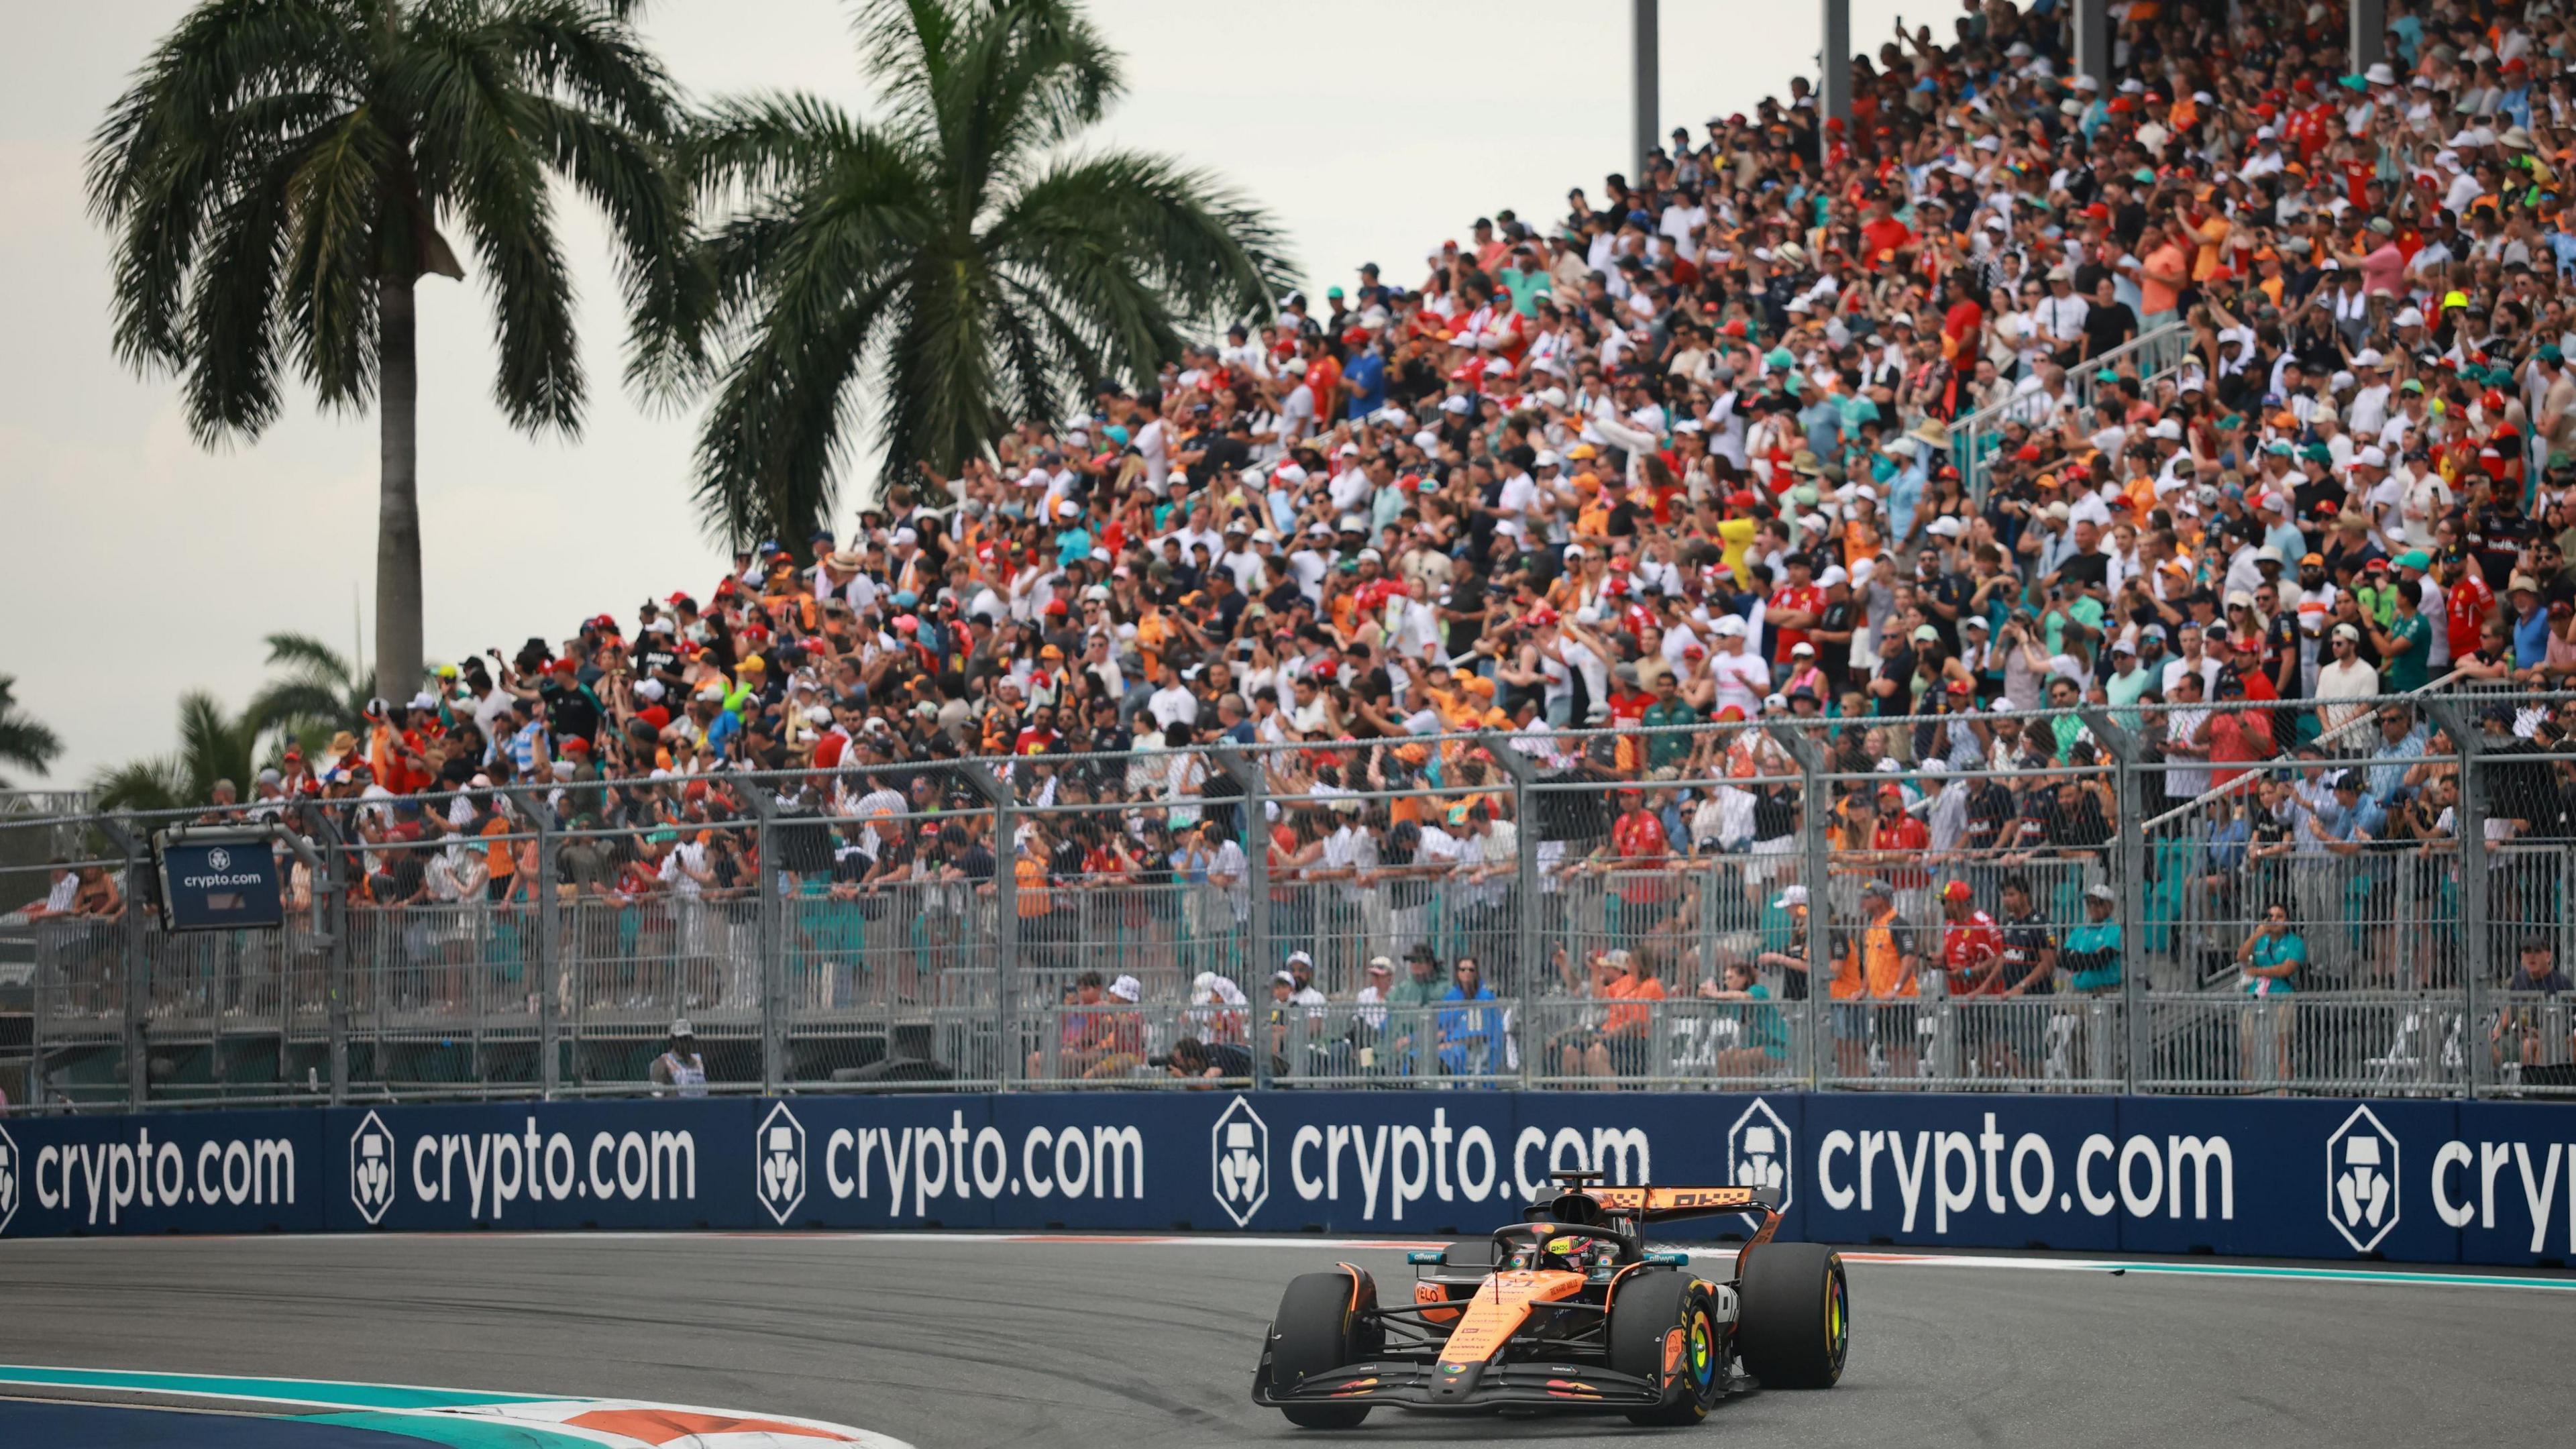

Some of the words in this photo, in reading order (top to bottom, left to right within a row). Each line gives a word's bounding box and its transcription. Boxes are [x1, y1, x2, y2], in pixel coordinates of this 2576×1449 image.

[184, 873, 261, 888] crypto.com
[36, 1128, 294, 1224] crypto.com
[413, 1116, 695, 1219] crypto.com
[826, 1110, 1144, 1217] crypto.com
[1291, 1107, 1650, 1221] crypto.com
[1818, 1112, 2233, 1233] crypto.com
[1649, 1254, 1676, 1263] allwyn
